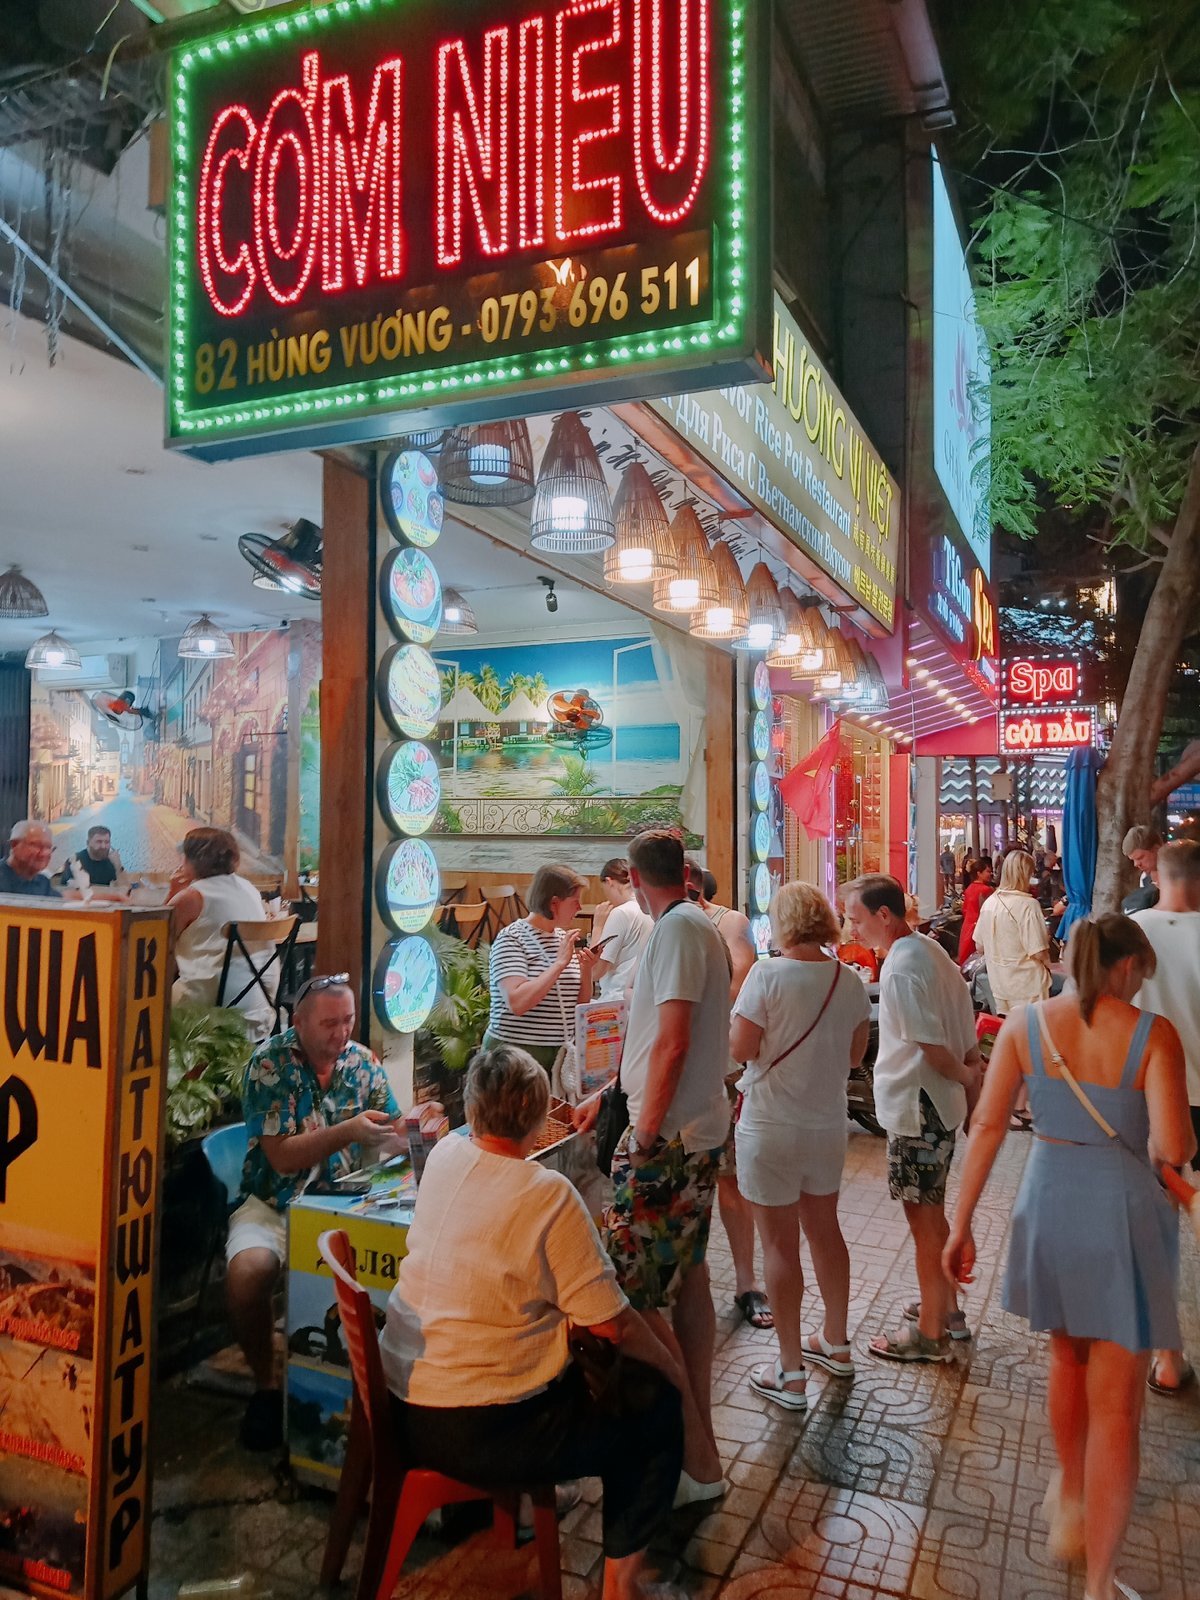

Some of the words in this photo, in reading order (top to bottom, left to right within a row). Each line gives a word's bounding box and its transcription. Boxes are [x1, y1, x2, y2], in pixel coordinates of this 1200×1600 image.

[198, 50, 401, 316] CƠM
[195, 338, 238, 394] 82
[247, 328, 332, 386] HÙNG
[340, 305, 453, 368] VƯƠNG
[481, 286, 557, 343] 0793
[568, 271, 630, 328] 696
[640, 256, 700, 315] 511
[712, 411, 744, 480] Риса
[757, 460, 825, 557] Вьетнамским
[755, 394, 782, 460] Rice
[784, 431, 802, 485] Pot
[805, 456, 851, 539] Restaurant
[771, 310, 847, 480] HƯƠNG
[850, 424, 864, 516] VỊ
[866, 452, 893, 547] VIỆT
[1005, 718, 1042, 748] GỘI
[1046, 711, 1090, 743] ĐẦU
[1010, 662, 1073, 701] Spa
